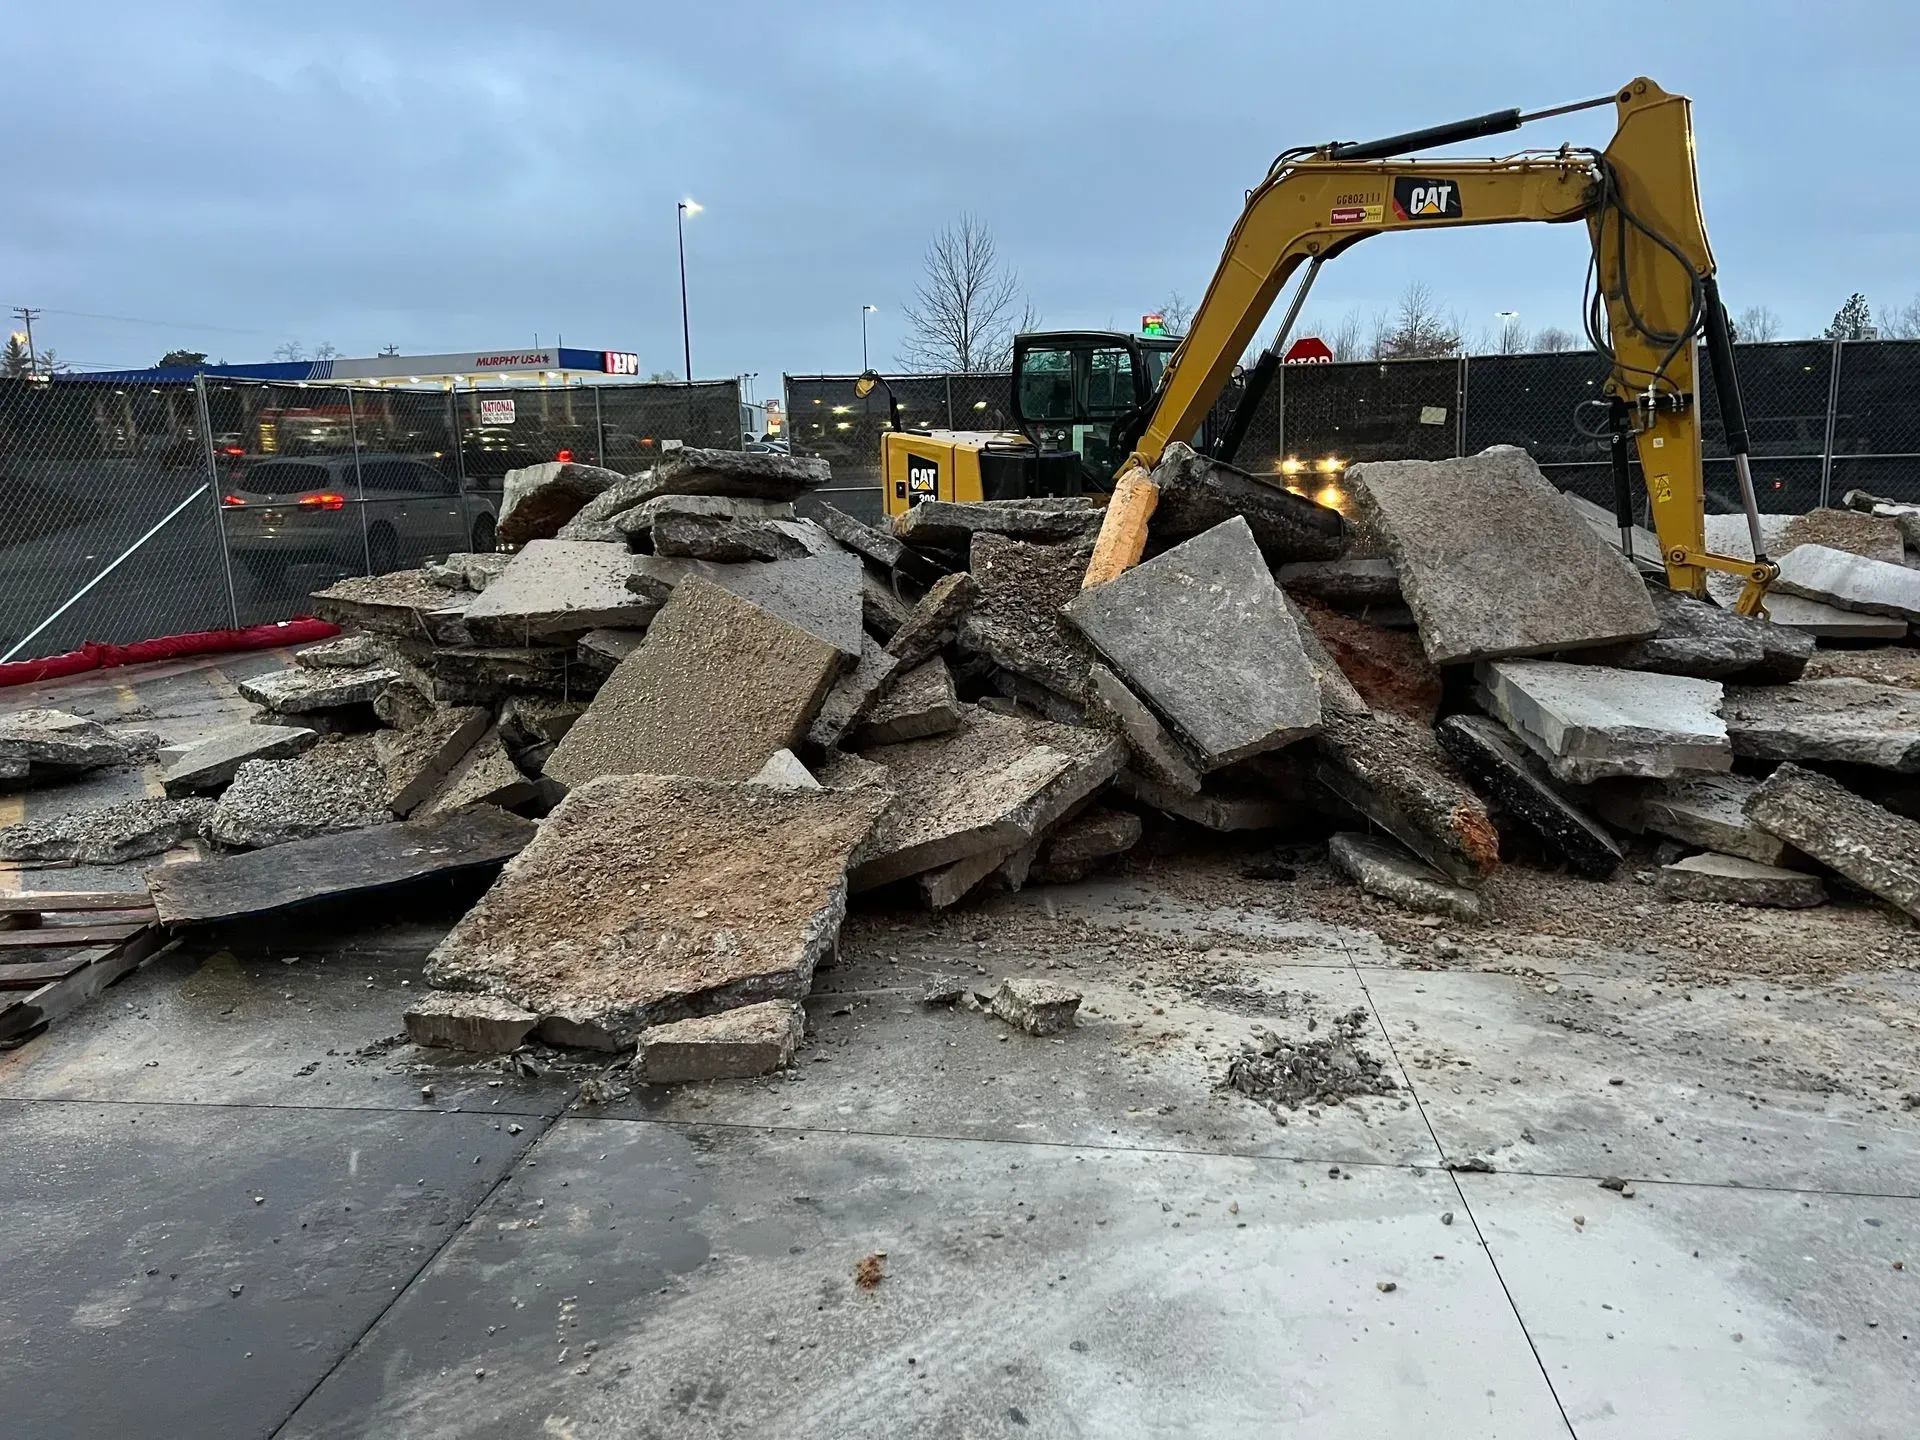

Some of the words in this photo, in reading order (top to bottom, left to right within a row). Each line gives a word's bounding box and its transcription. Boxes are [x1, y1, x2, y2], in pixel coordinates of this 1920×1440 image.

[1410, 186, 1451, 214] CAT
[476, 355, 519, 367] MURPHY
[521, 354, 542, 365] USA
[482, 401, 514, 412] NATIONAL
[911, 468, 935, 490] CAT
